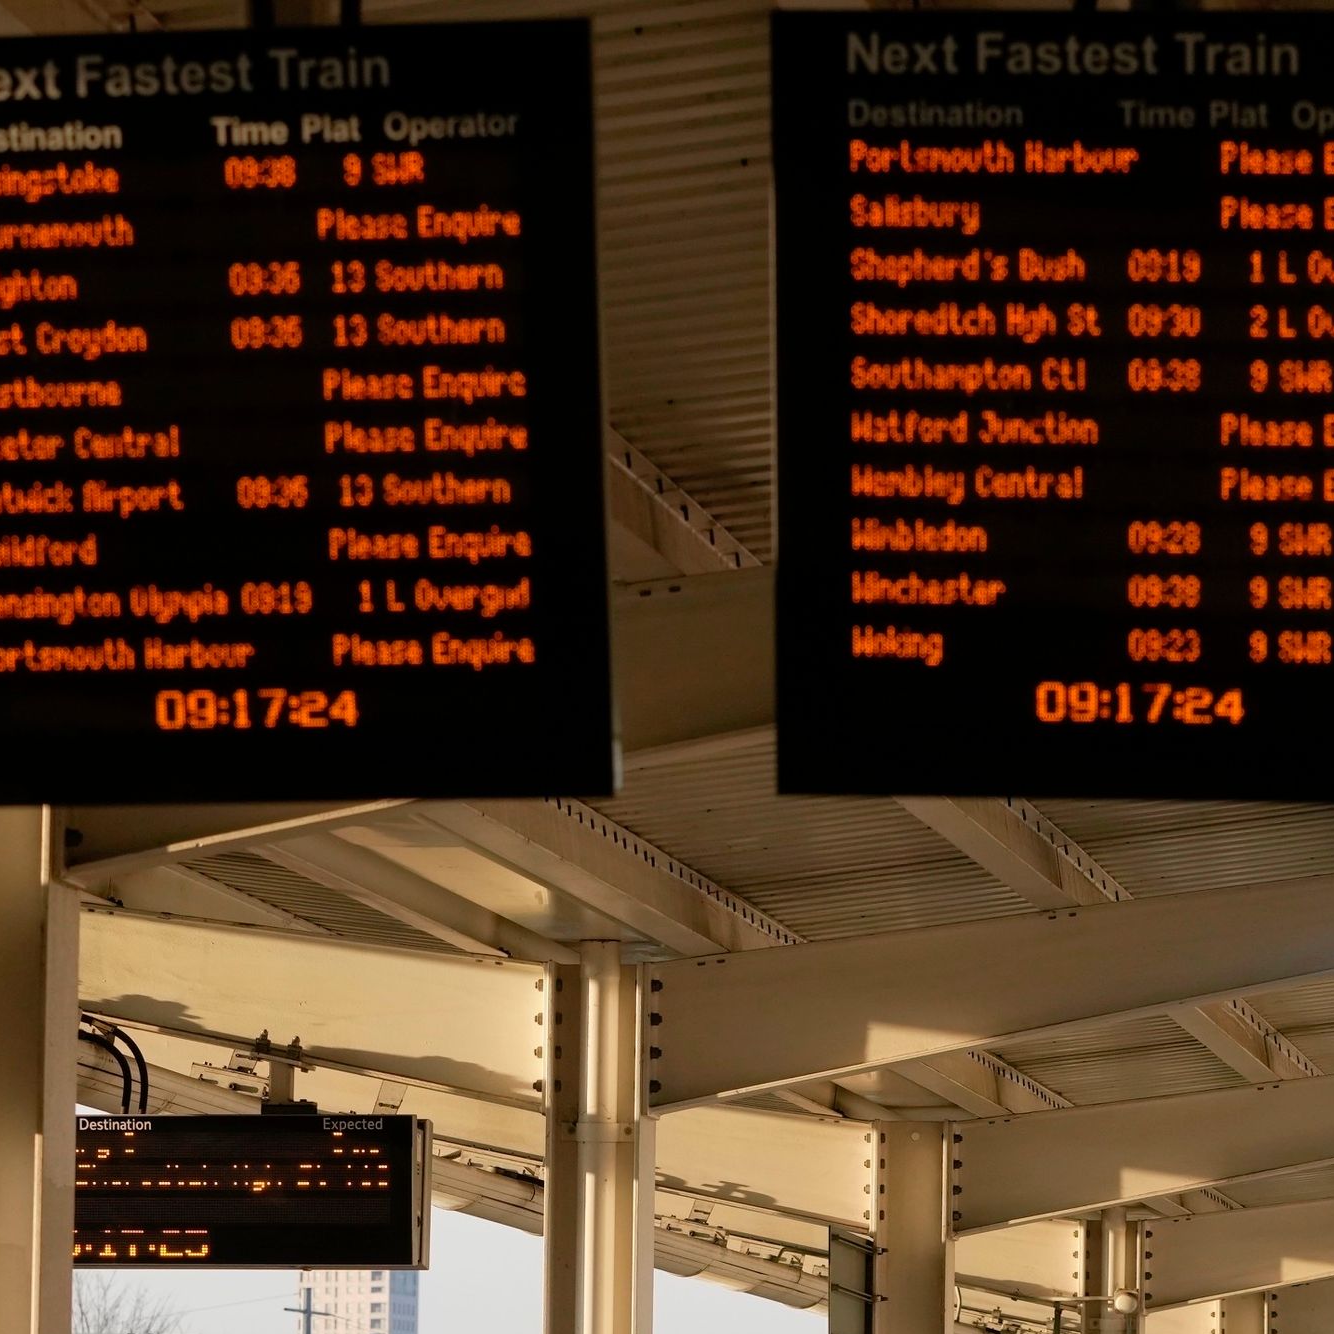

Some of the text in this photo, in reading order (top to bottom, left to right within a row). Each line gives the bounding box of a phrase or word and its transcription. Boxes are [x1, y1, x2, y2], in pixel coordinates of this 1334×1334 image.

[848, 32, 1298, 75] Next Fastest Train
[76, 55, 252, 98] Fastest
[269, 48, 389, 89] Train
[212, 117, 288, 146] Time
[302, 115, 360, 143] Plat
[384, 112, 516, 146] Operator
[848, 99, 1023, 127] Destination
[1120, 100, 1195, 128] Time
[1210, 100, 1267, 127] Plat
[344, 154, 361, 186] 9
[372, 152, 424, 185] SWR
[850, 140, 1014, 172] Portsmouth
[1025, 141, 1138, 173] Harbour
[1221, 141, 1312, 174] Please
[317, 208, 407, 240] Please
[417, 205, 520, 243] Enquire
[851, 194, 979, 235] Salisbury
[1221, 196, 1313, 229] Please
[332, 261, 365, 293] 13
[376, 260, 503, 292] Southern
[851, 248, 1008, 287] Shepherd's
[1019, 248, 1085, 281] Bush
[1128, 249, 1200, 282] 09:19
[1251, 251, 1263, 283] 1
[1279, 253, 1296, 283] L
[36, 320, 147, 360] Croydon
[334, 314, 367, 346] 13
[378, 314, 505, 344] Southern
[851, 303, 996, 335] Shoreditch
[1068, 304, 1100, 336] St
[1128, 304, 1200, 336] 09:30
[1250, 305, 1267, 338] 2
[1279, 309, 1296, 338] L
[323, 369, 413, 400] Please
[423, 366, 525, 404] Enquire
[852, 357, 1031, 393] Southampton
[1042, 358, 1085, 390] Ctl
[1250, 360, 1268, 392] 9
[1279, 360, 1332, 392] SWR
[75, 425, 179, 458] Central
[325, 422, 415, 453] Please
[425, 418, 527, 455] Enquire
[851, 411, 968, 443] Watford
[979, 411, 1098, 444] Junction
[1221, 413, 1313, 446] Please
[83, 480, 184, 518] Airport
[341, 474, 373, 506] 13
[383, 473, 510, 504] Southern
[852, 465, 965, 504] Wembley
[975, 466, 1083, 498] Central
[1221, 468, 1313, 501] Please
[329, 528, 418, 560] Please
[429, 526, 531, 564] Enquire
[852, 519, 1331, 555] Wimbledon 09:28 9 SWR
[130, 584, 228, 623] Olympia
[241, 582, 312, 614] 09:19
[359, 581, 373, 612] 1
[387, 581, 404, 611] L
[852, 572, 1005, 605] Winchester
[1250, 576, 1268, 608] 9
[1279, 576, 1331, 609] SWR
[145, 640, 254, 669] Harbour
[333, 634, 422, 665] Please
[432, 632, 534, 670] Enquire
[852, 626, 943, 666] Woking
[1250, 631, 1267, 662] 9
[1279, 631, 1331, 663] SWR
[156, 688, 359, 729] 09:17:24
[1036, 682, 1244, 724] 09:17:24
[79, 1117, 383, 1132] Destination Expected
